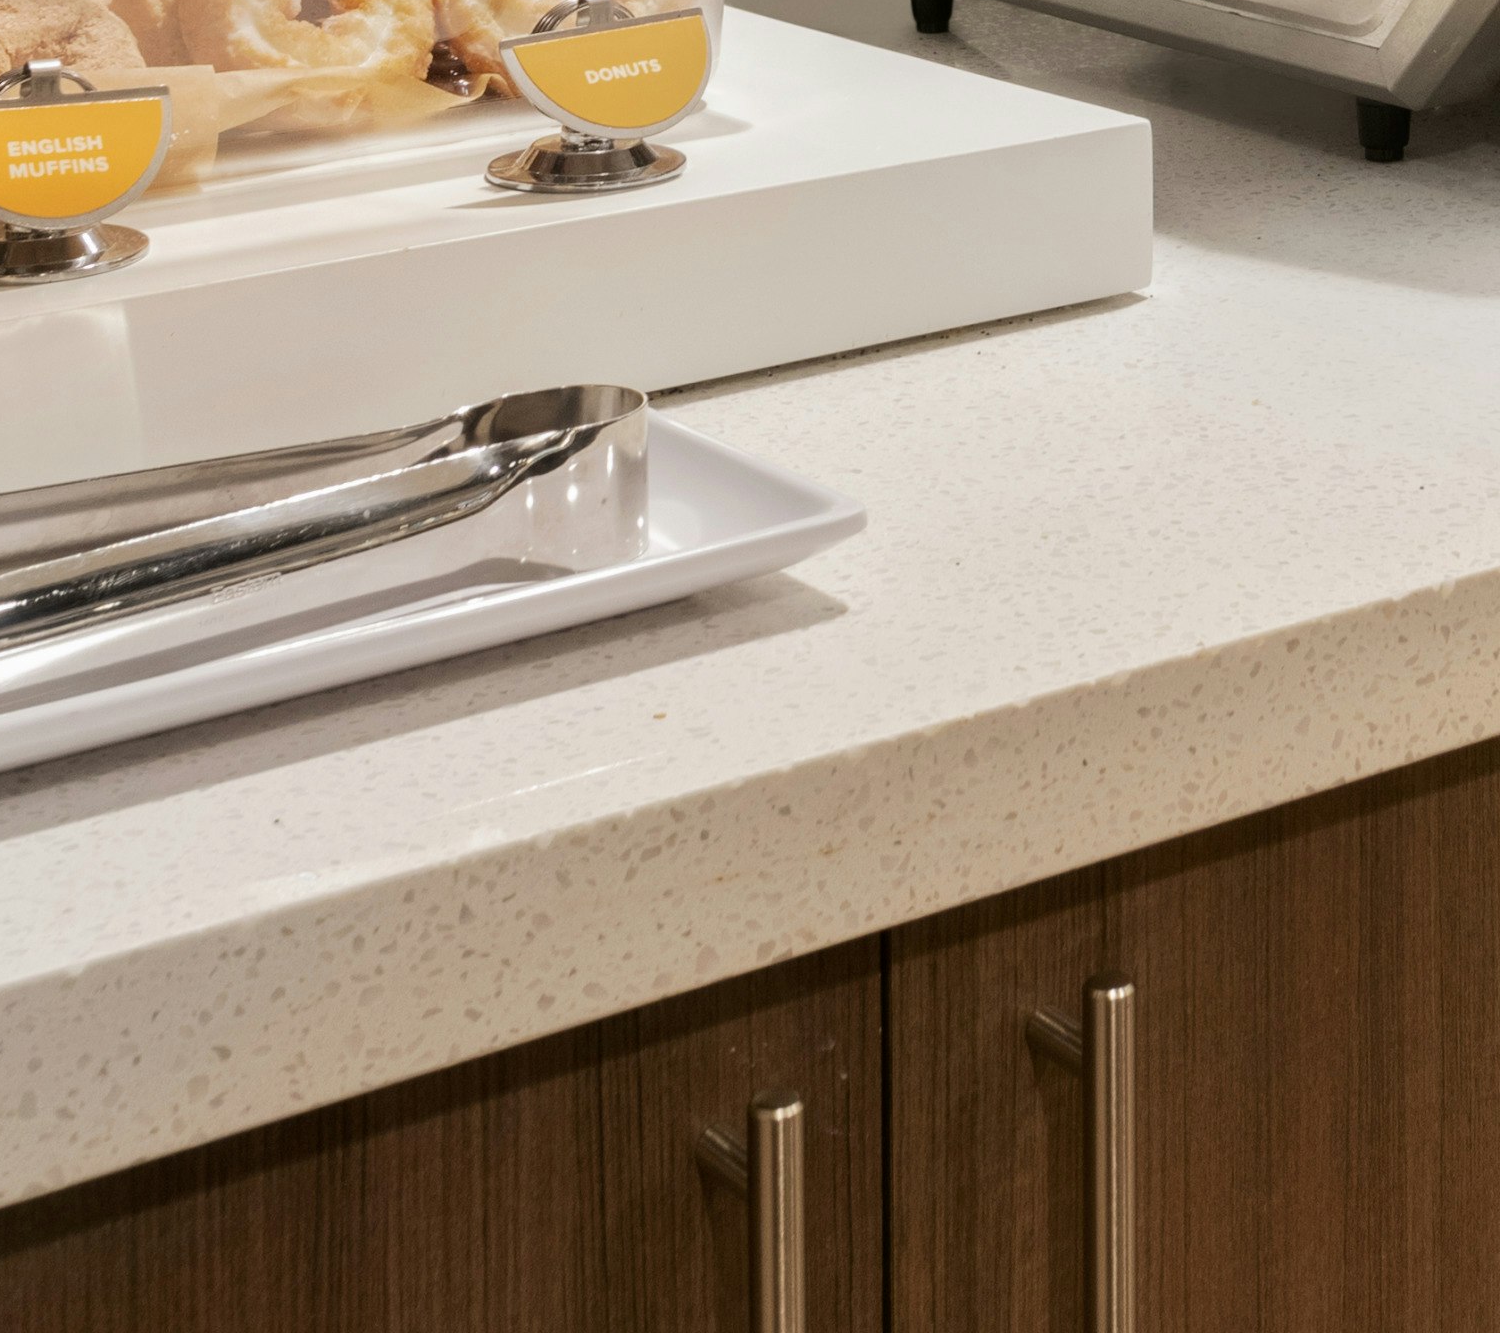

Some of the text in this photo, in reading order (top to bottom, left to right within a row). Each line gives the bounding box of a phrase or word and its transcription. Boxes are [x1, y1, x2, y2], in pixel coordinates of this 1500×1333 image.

[585, 58, 662, 84] DONUTS
[7, 134, 103, 157] ENGLISH
[9, 156, 110, 180] MUFFINS
